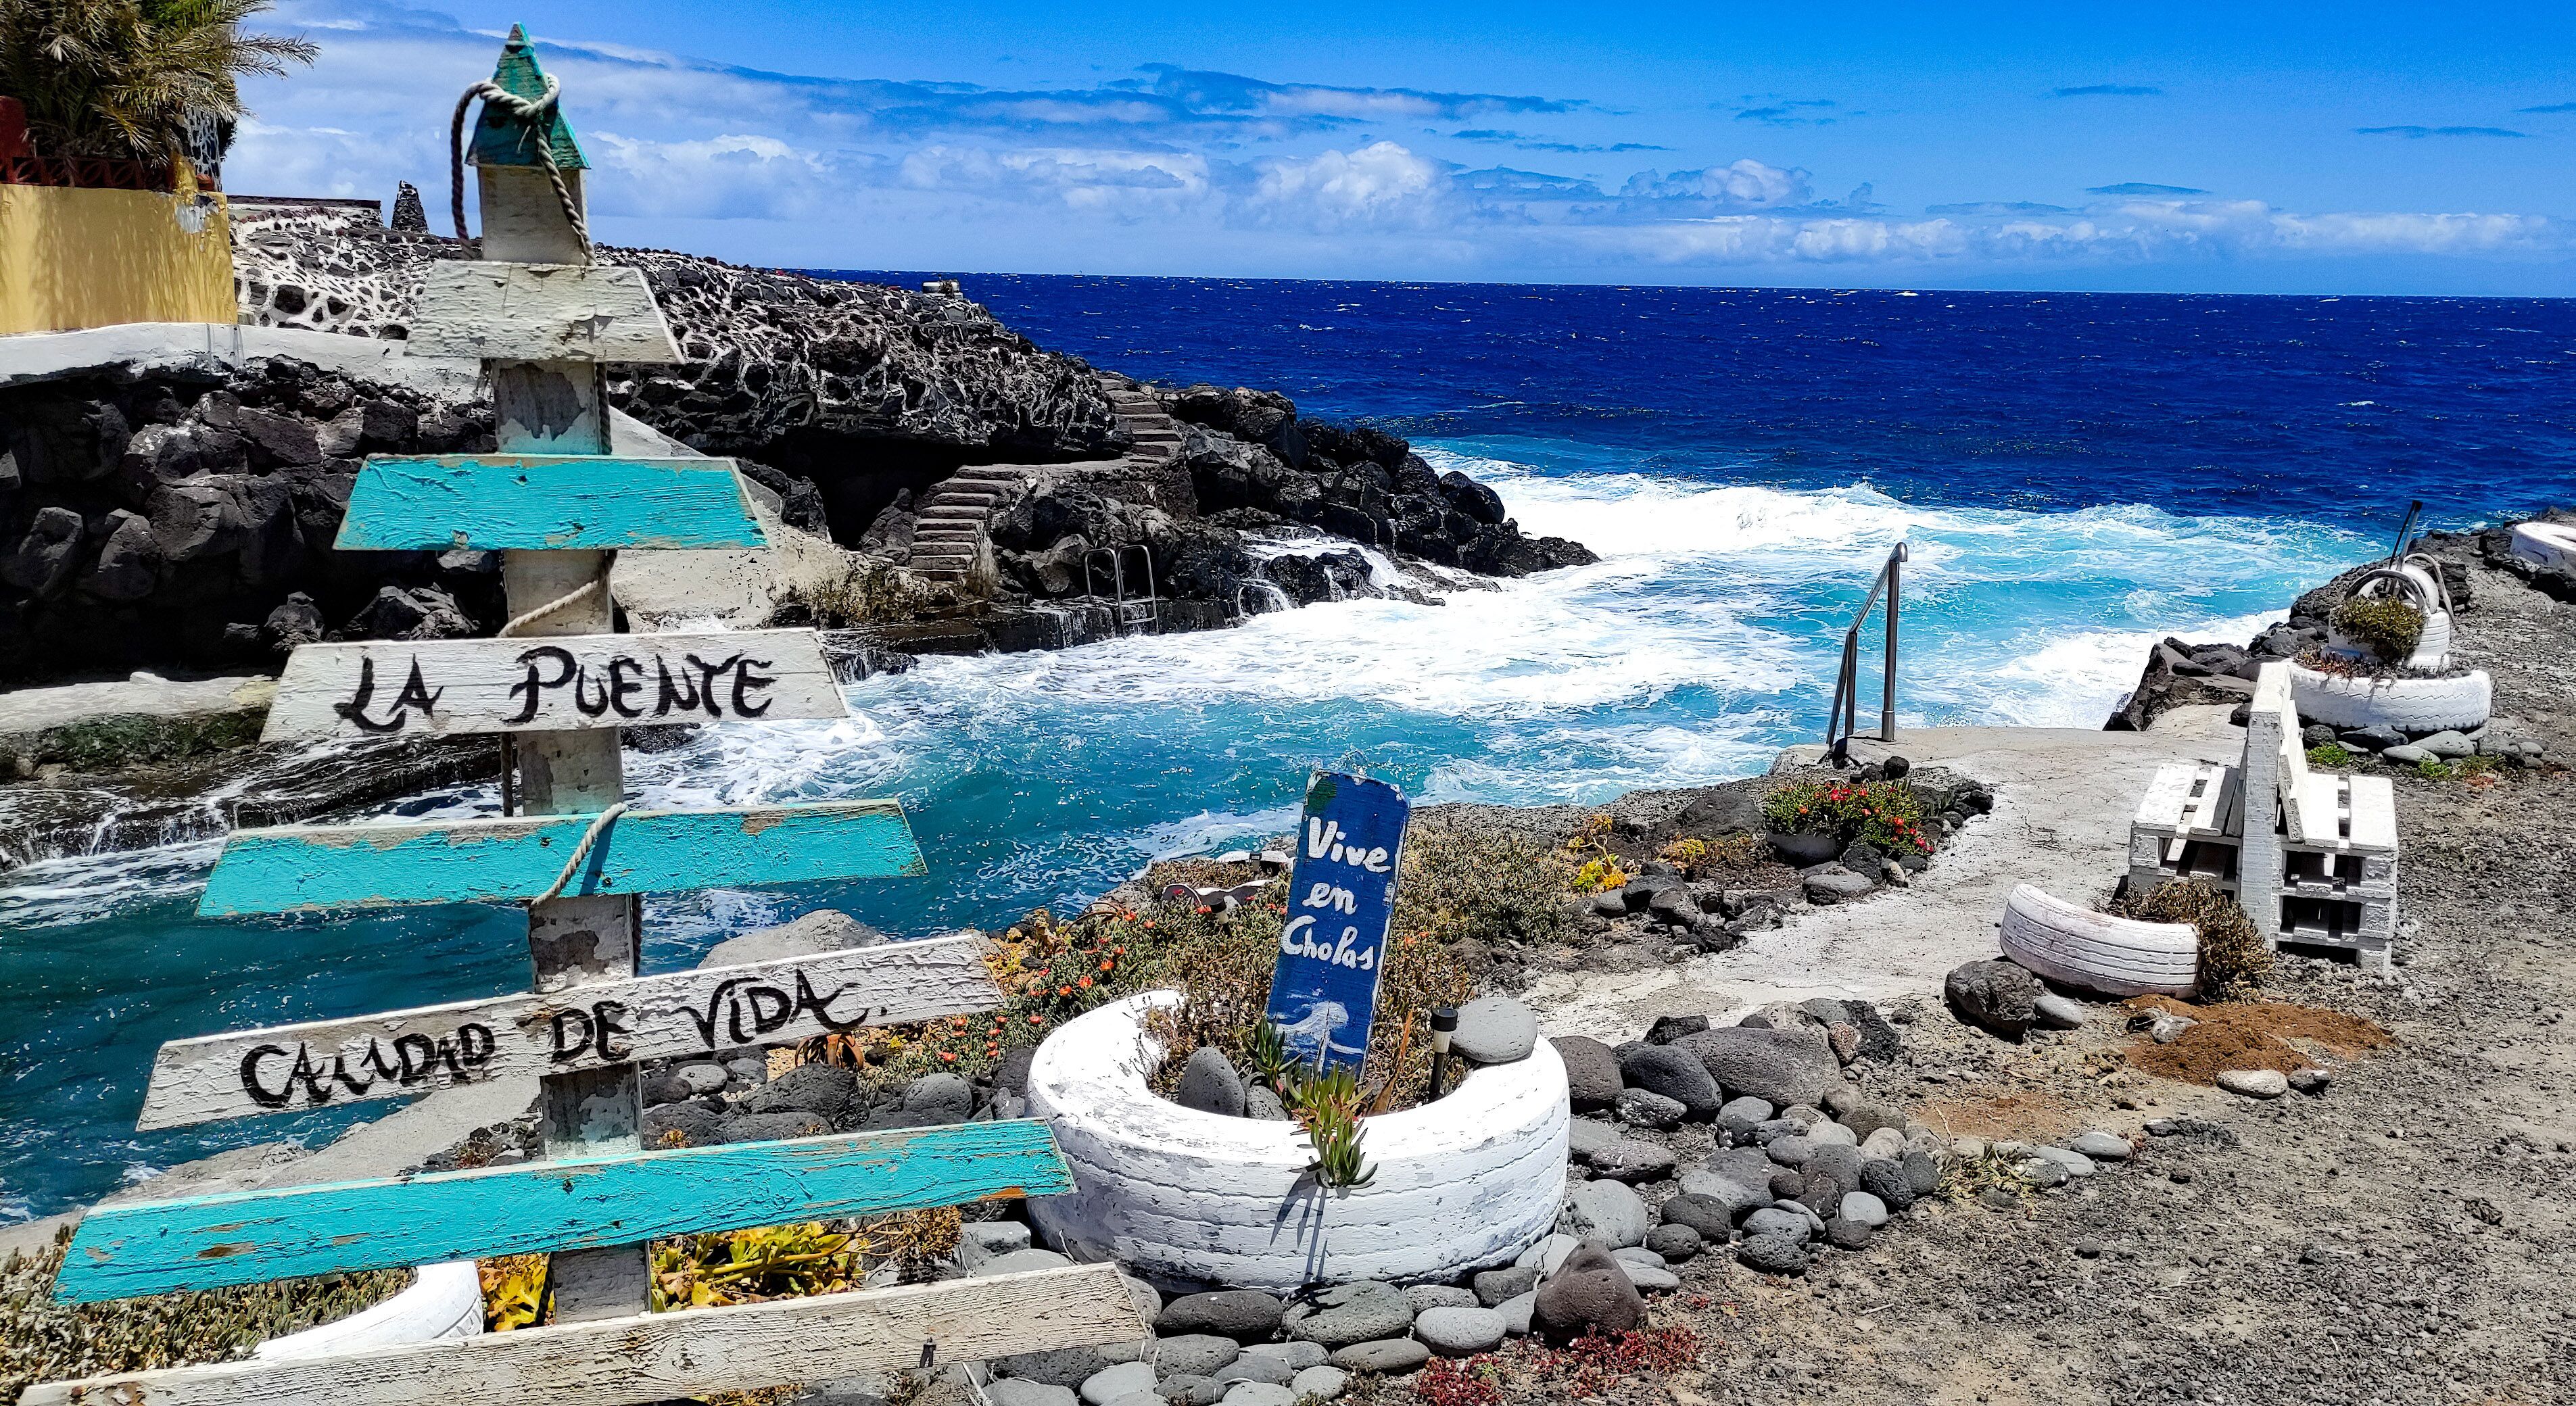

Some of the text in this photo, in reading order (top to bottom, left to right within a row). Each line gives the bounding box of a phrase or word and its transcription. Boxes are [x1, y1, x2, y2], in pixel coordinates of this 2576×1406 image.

[333, 645, 776, 733] LA PUENTE
[1308, 817, 1392, 873] Vive
[1302, 882, 1357, 915] en
[1283, 915, 1375, 970] Cholas
[240, 1022, 496, 1109] CALIDAD
[550, 1000, 633, 1063] DE
